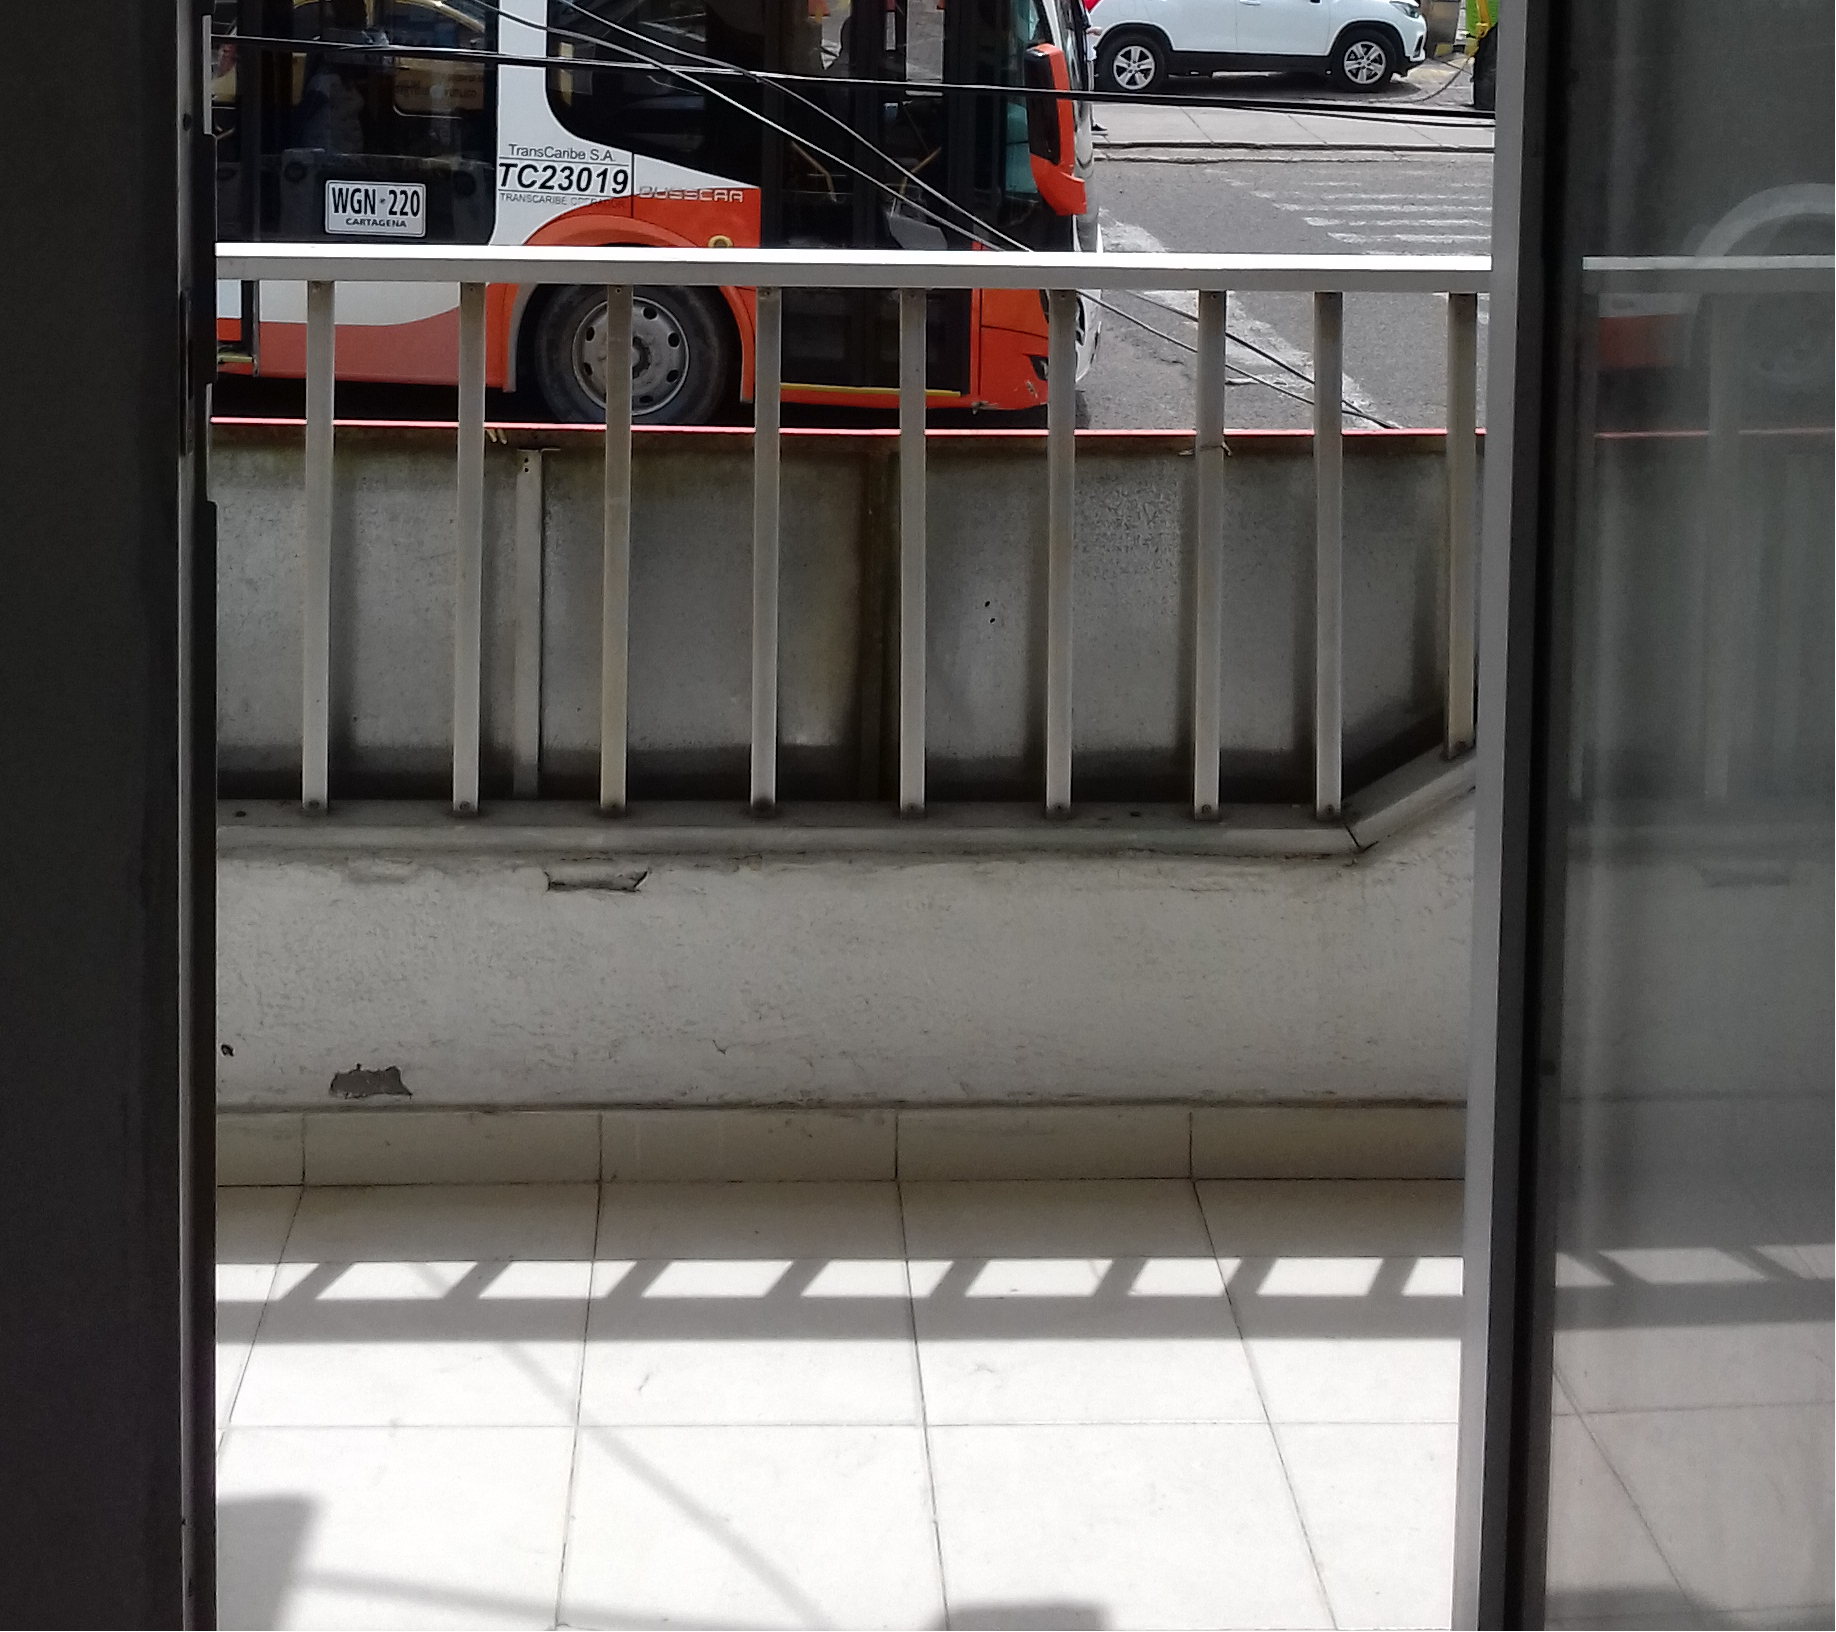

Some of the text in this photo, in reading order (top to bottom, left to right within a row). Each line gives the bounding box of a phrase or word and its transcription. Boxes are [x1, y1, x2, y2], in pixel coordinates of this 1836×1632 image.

[508, 144, 586, 160] TransCaribe
[499, 162, 629, 195] TC23019
[500, 192, 568, 206] TRANSCARIBE
[639, 186, 744, 203] BUSSCAR
[388, 189, 420, 217] 220
[345, 218, 407, 228] CARTAGENA
